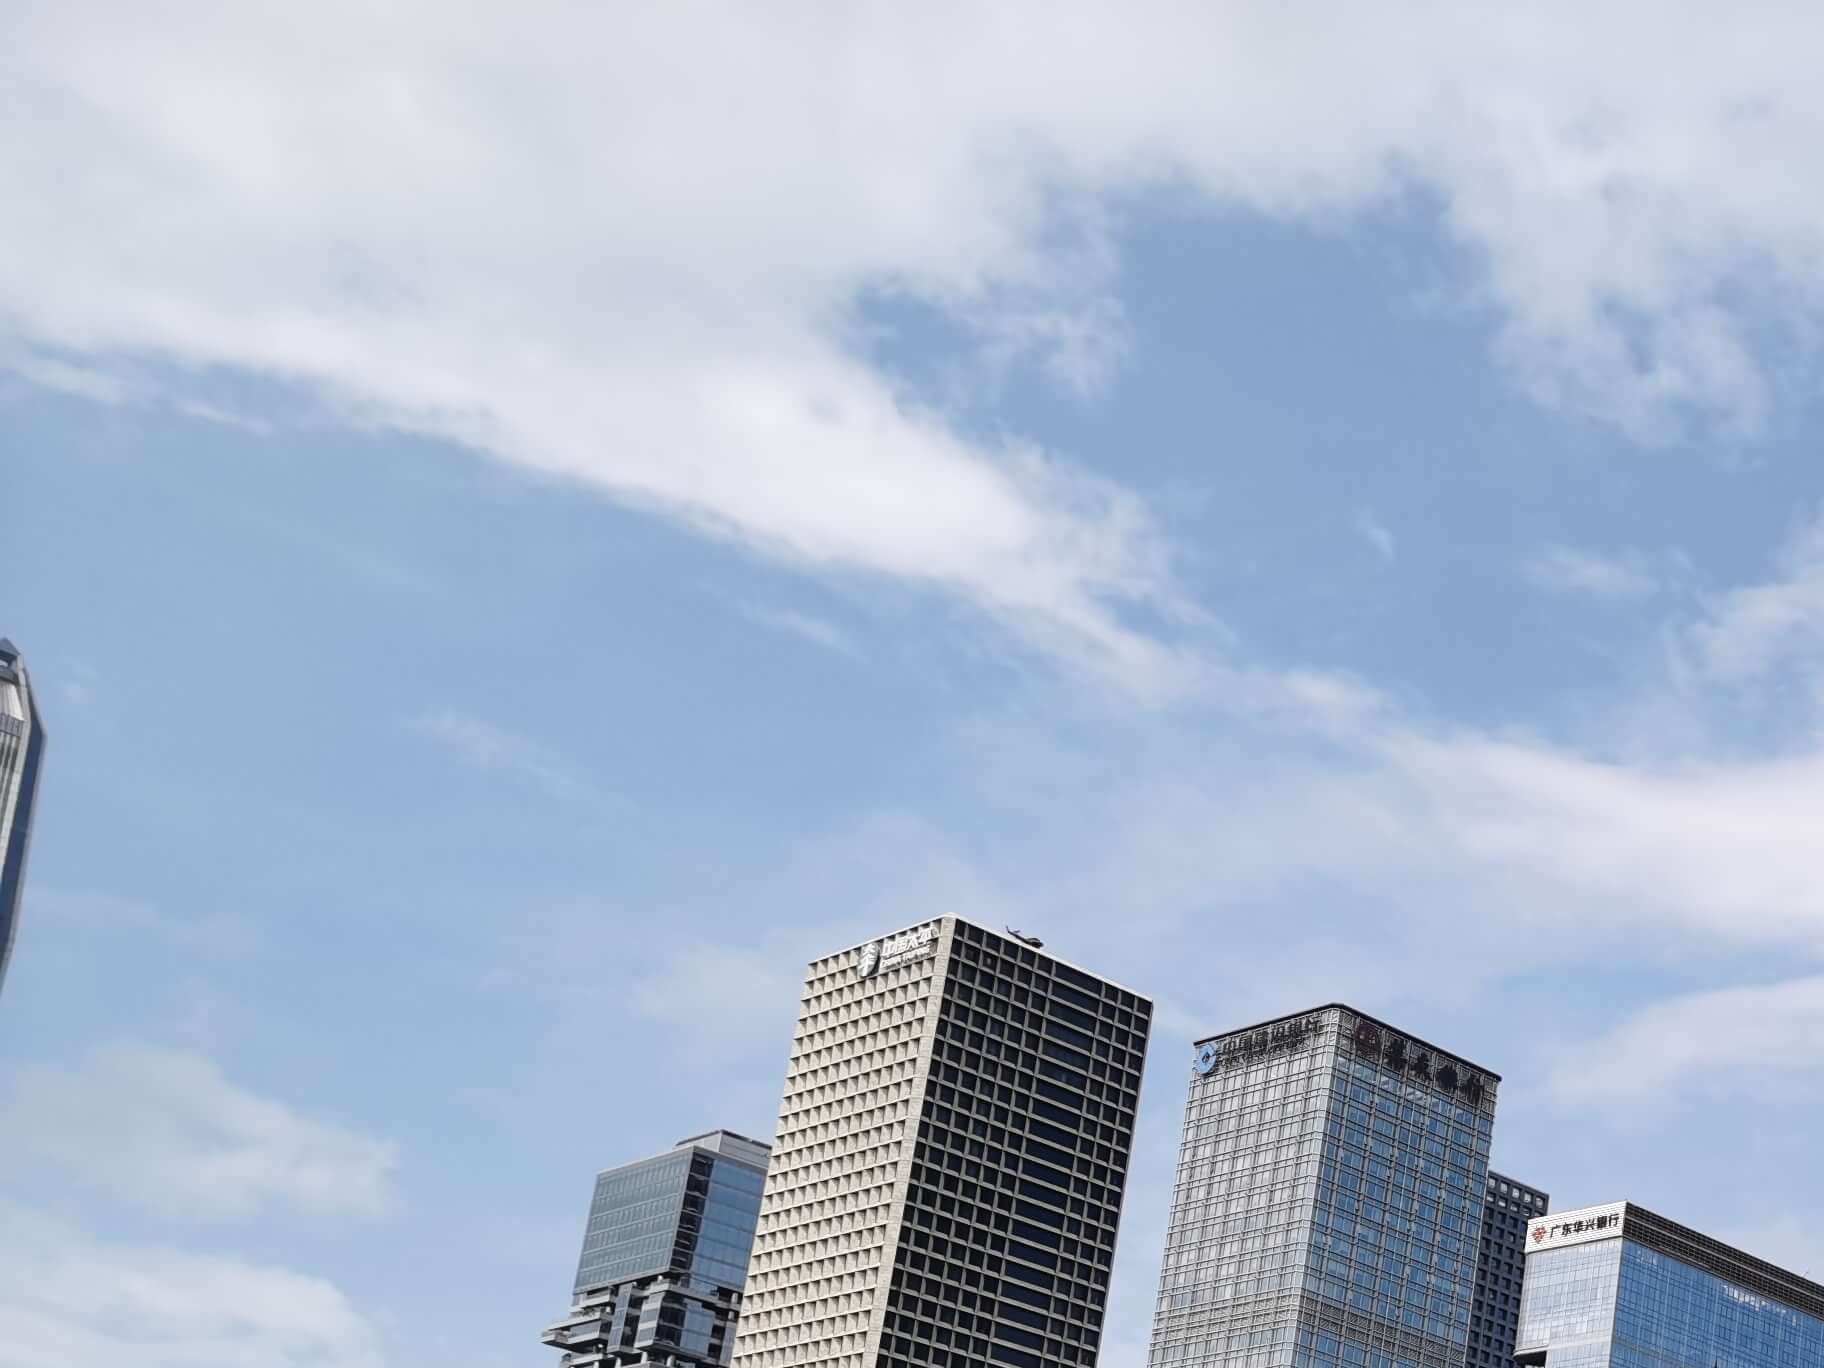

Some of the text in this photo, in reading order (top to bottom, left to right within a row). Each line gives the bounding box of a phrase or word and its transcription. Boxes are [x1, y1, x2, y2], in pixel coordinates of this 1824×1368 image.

[1549, 1213, 1620, 1240] 广东华兴银行
